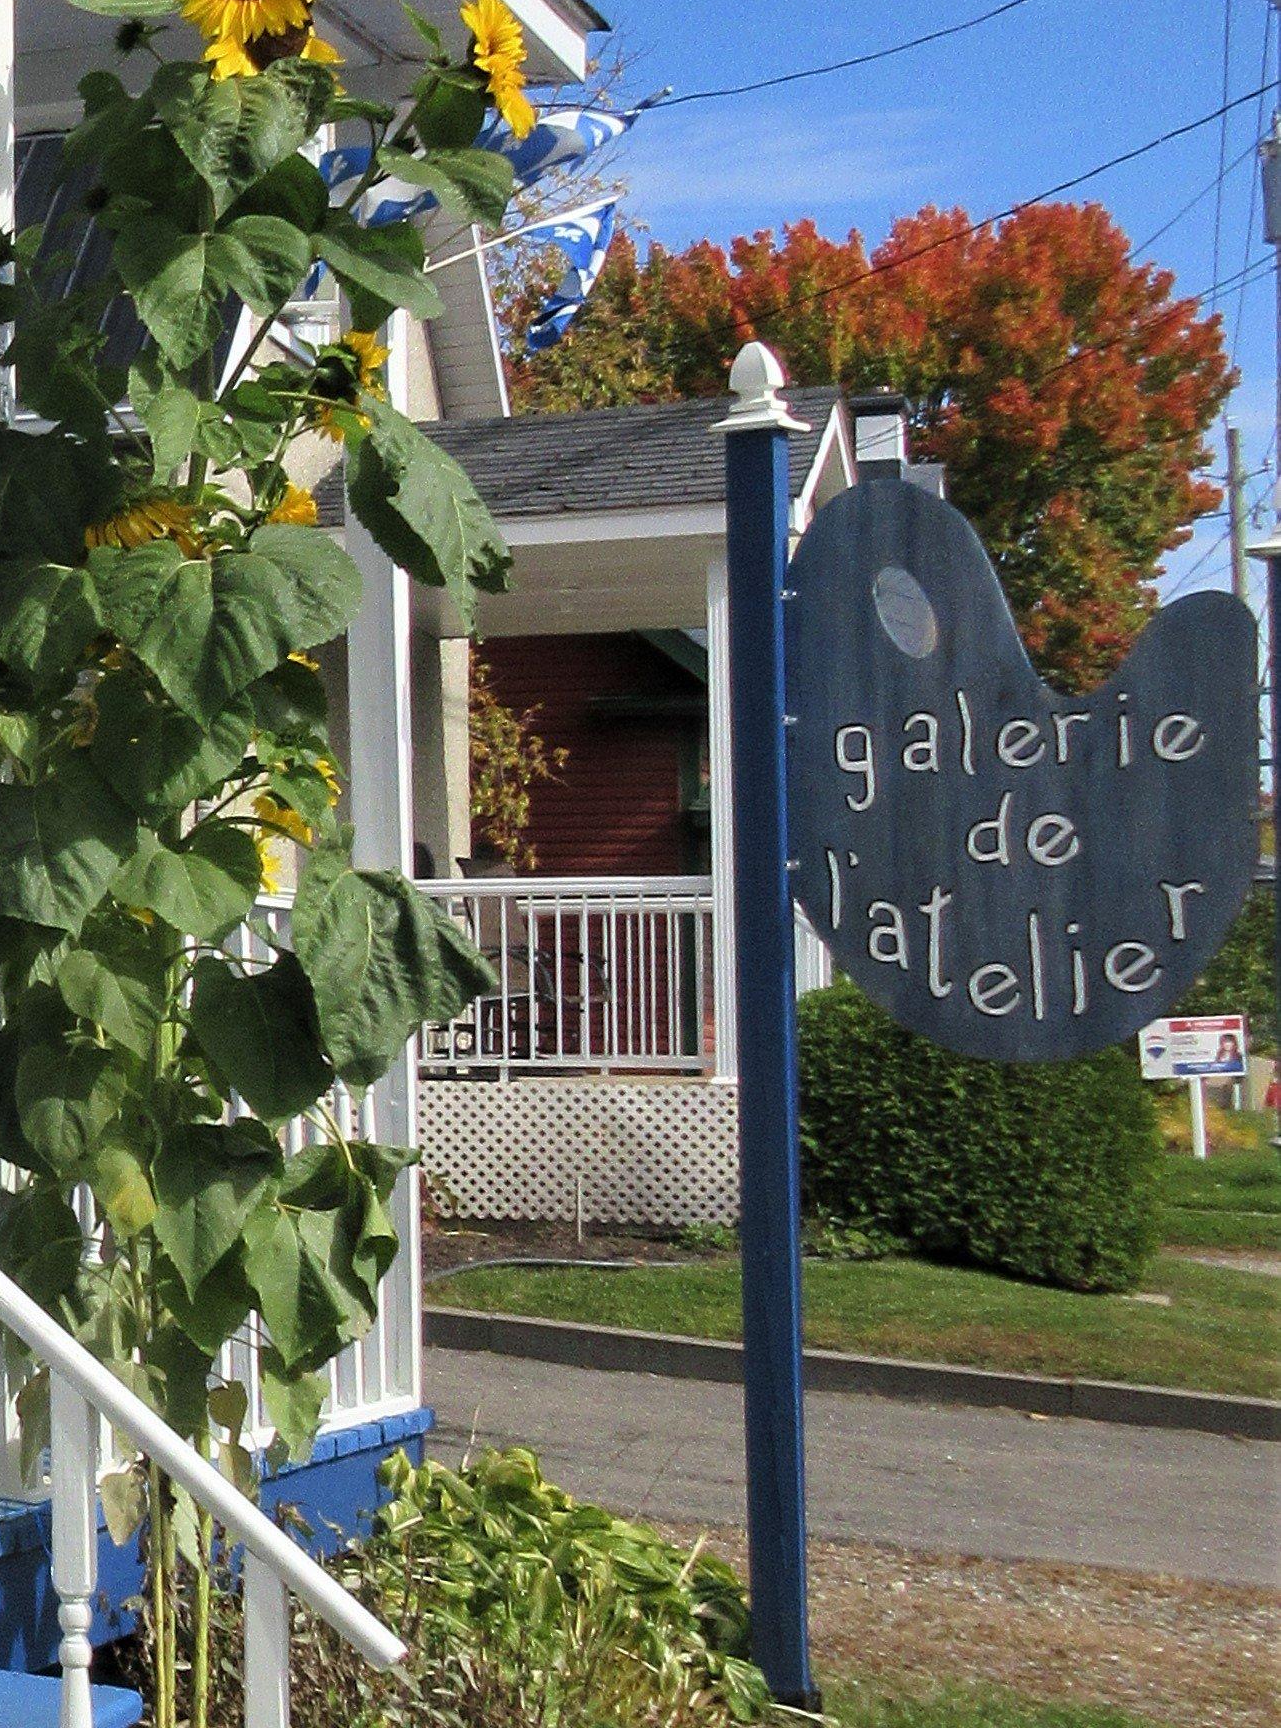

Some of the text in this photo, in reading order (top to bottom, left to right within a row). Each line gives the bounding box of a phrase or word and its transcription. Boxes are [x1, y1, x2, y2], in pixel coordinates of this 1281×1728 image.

[836, 691, 1205, 811] galerie
[967, 792, 1079, 866] de
[828, 851, 1204, 1020] l'atelier
